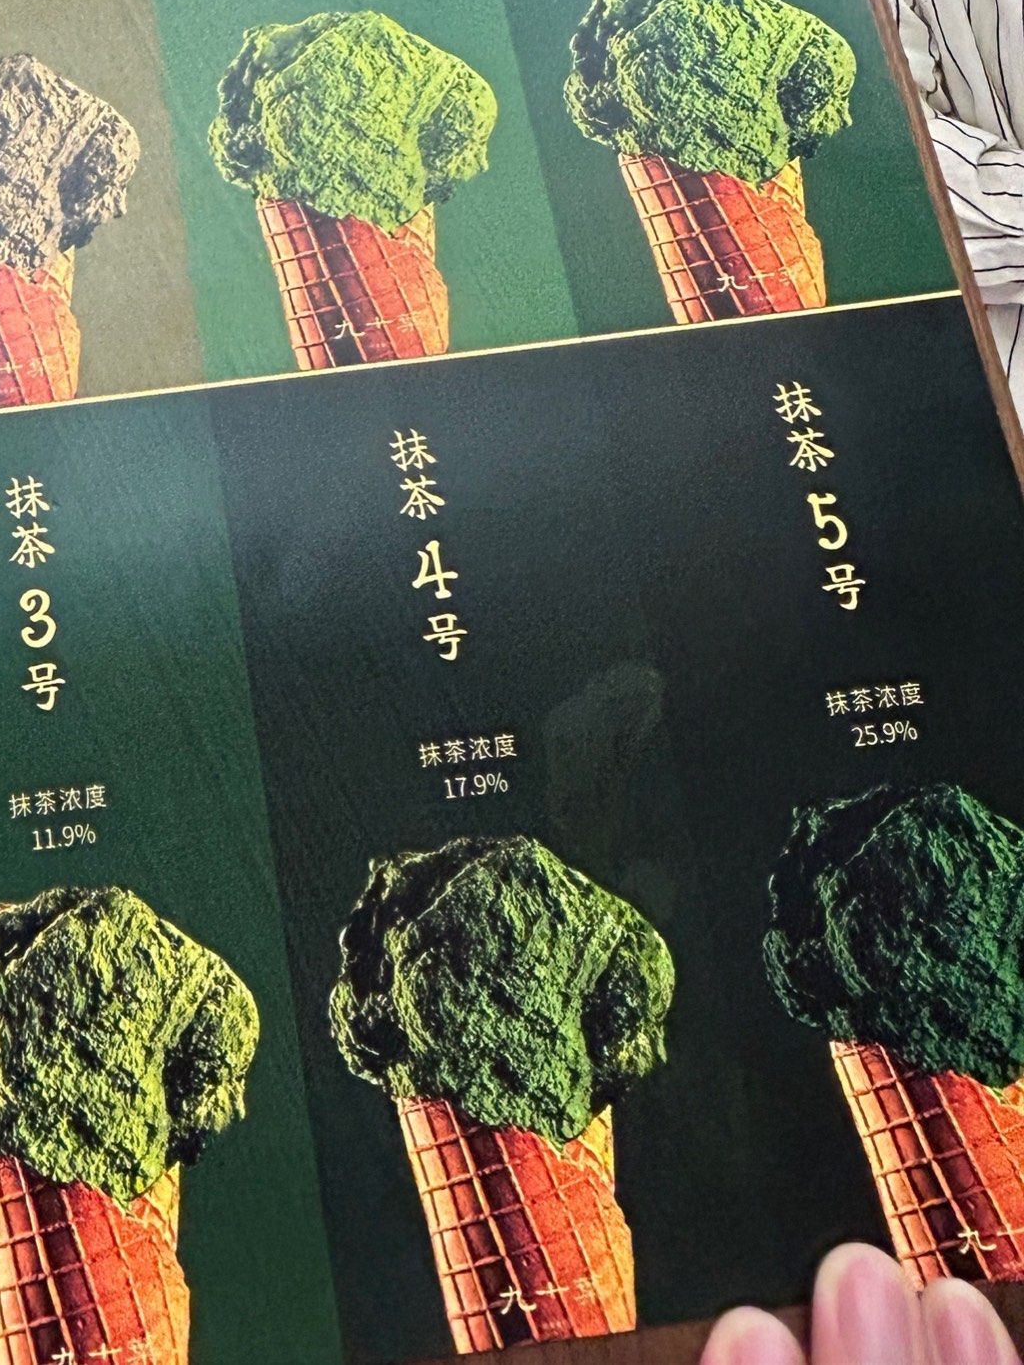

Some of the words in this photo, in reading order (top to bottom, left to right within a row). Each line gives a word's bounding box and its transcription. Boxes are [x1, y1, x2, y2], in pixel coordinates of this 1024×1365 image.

[772, 381, 866, 611] 抹茶5号
[389, 428, 468, 661] 抹茶4号
[5, 475, 66, 711] 抹茶3号
[825, 682, 925, 717] 抹茶浓度
[418, 734, 518, 768] 抹茶浓度
[851, 720, 919, 748] 25.9%
[8, 784, 107, 819] 抹茶浓度
[443, 772, 509, 800] 17.9%
[31, 824, 97, 851] 11.9%
